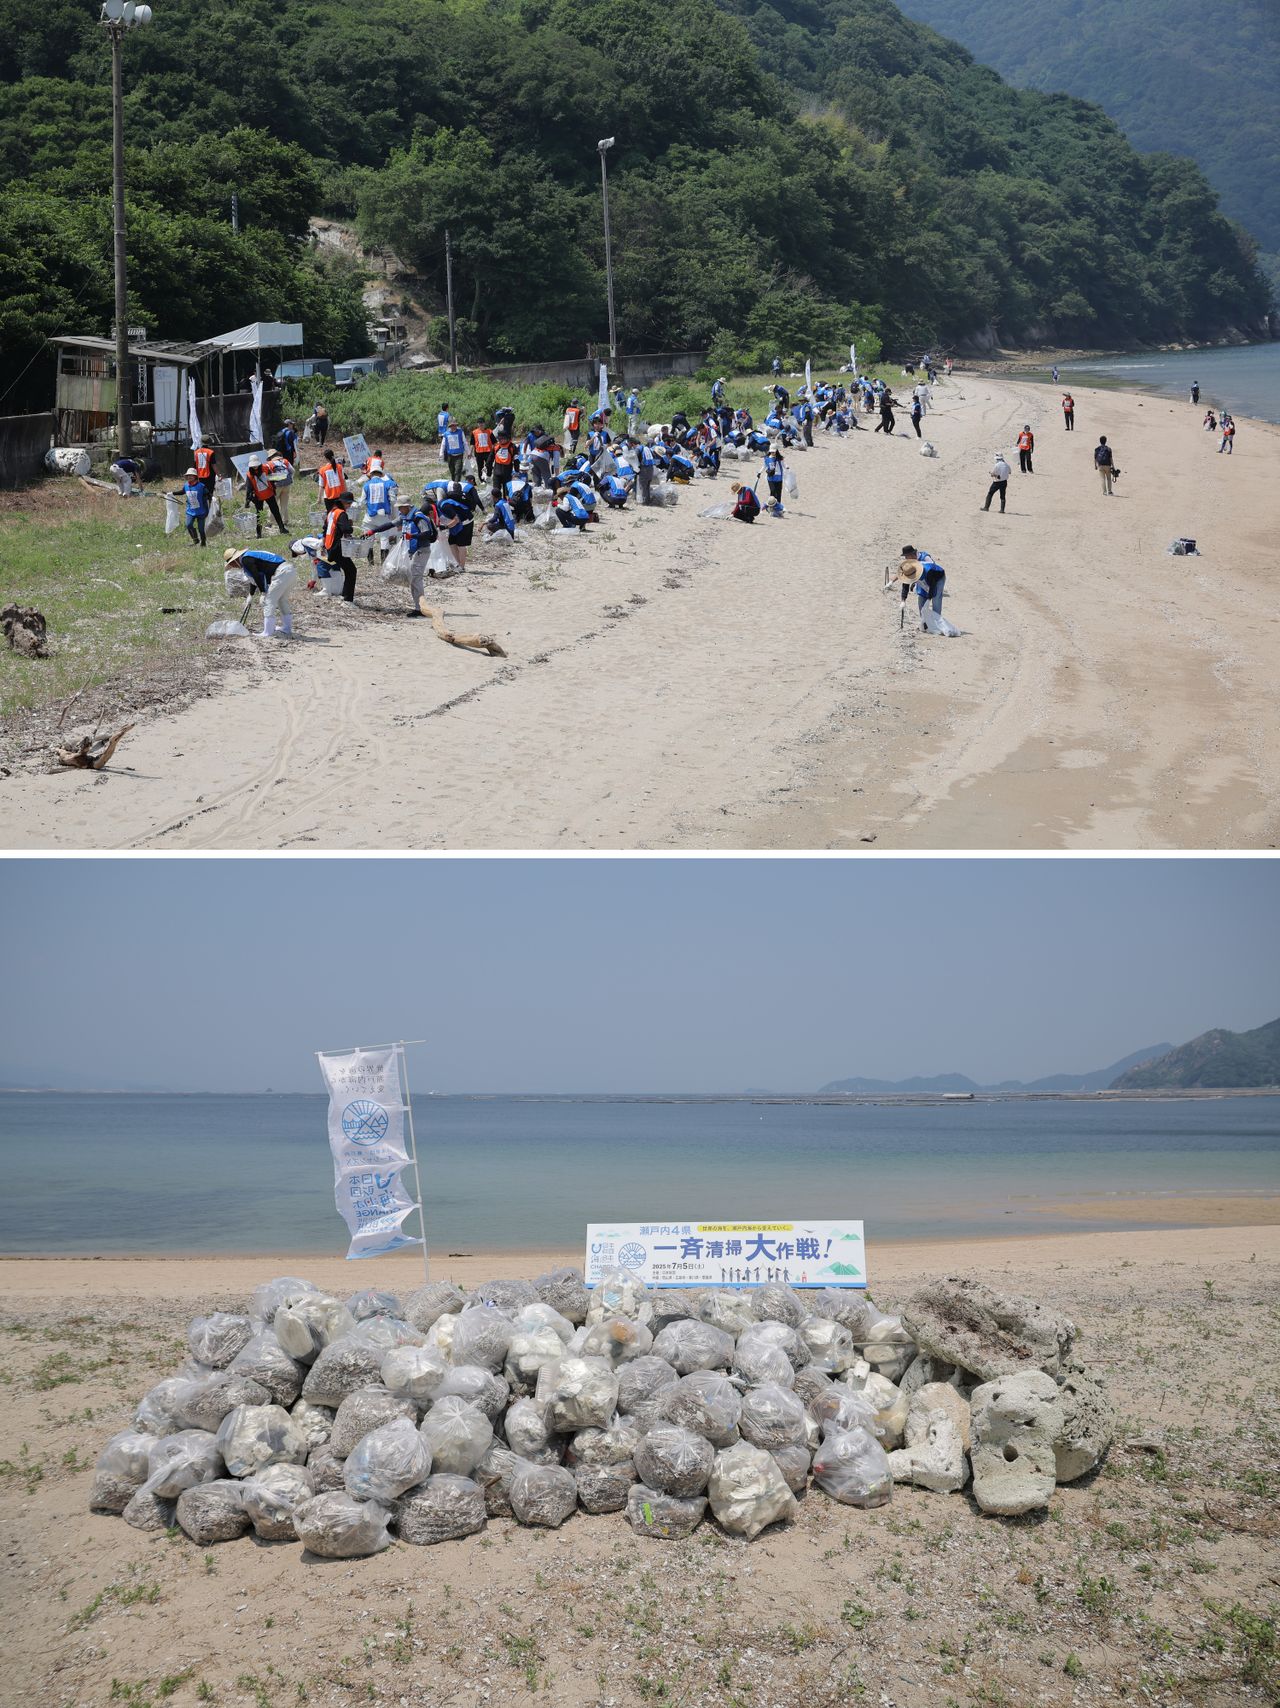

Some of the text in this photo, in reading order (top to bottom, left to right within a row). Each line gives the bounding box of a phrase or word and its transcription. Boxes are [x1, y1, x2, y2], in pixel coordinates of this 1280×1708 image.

[640, 1225, 691, 1236] 瀬戸内4県
[654, 1233, 833, 1262] 一斉清掃大作戦!
